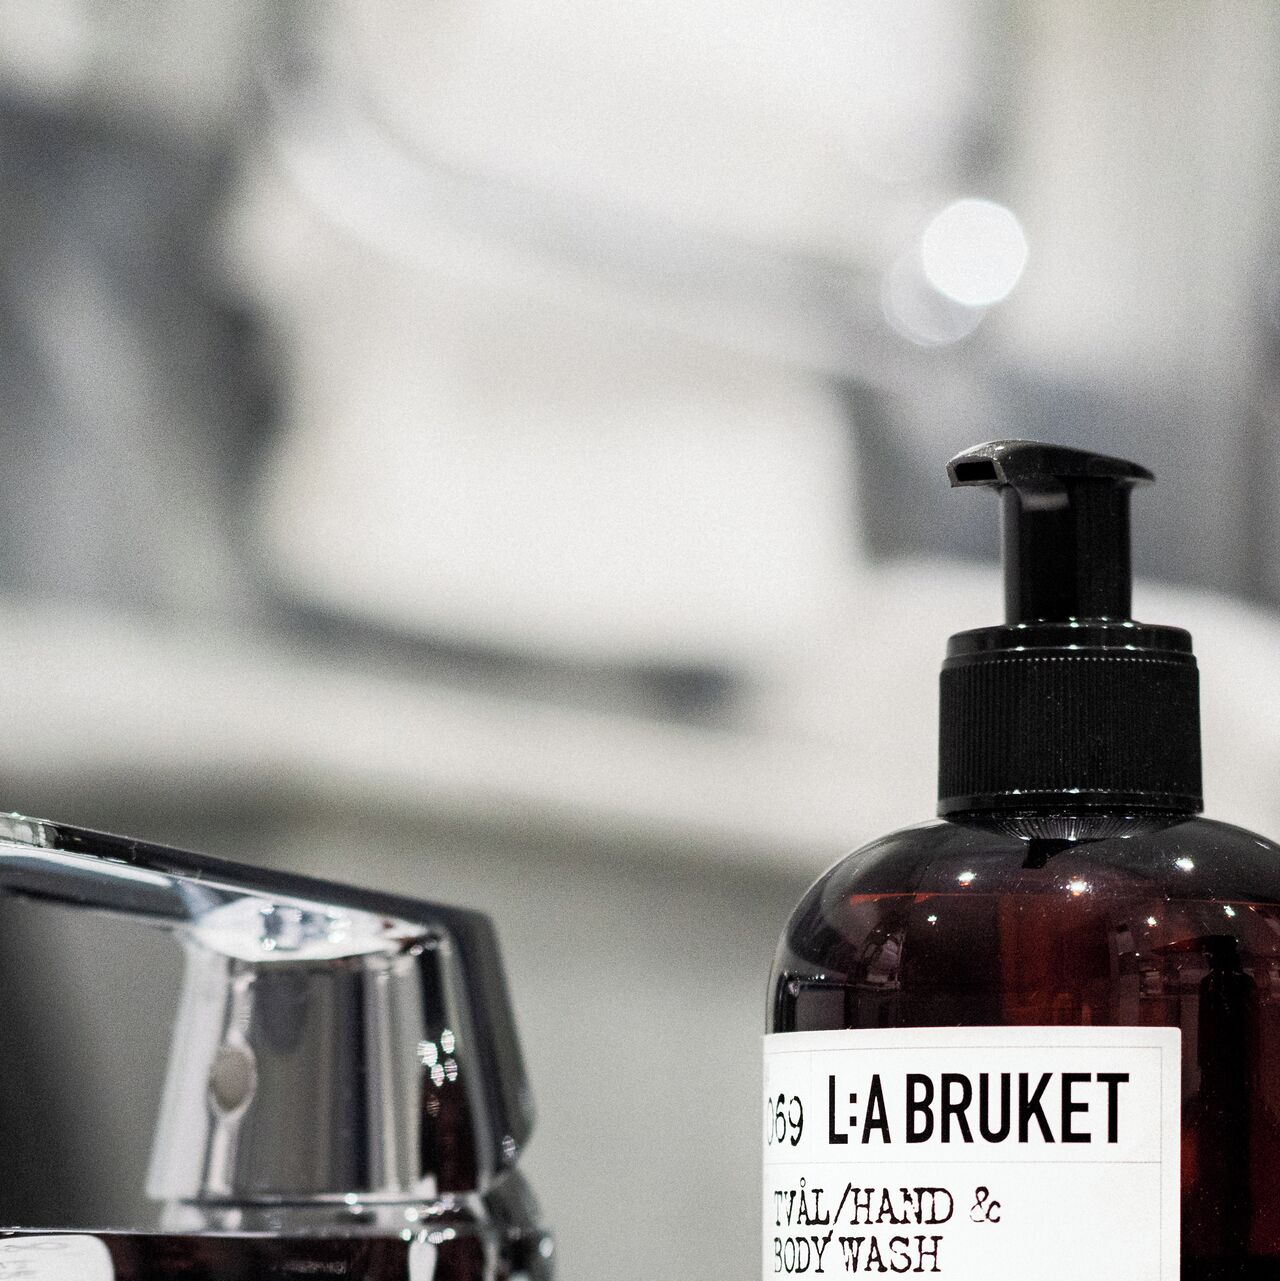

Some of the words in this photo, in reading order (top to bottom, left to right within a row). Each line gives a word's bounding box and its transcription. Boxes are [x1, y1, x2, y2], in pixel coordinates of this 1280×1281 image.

[828, 1074, 892, 1145] L:A
[905, 1072, 1130, 1144] BRUKET
[773, 1177, 954, 1230] TVÅL/HAND
[969, 1185, 1002, 1224] &
[773, 1231, 833, 1273] BODY
[838, 1235, 944, 1273] WASH
